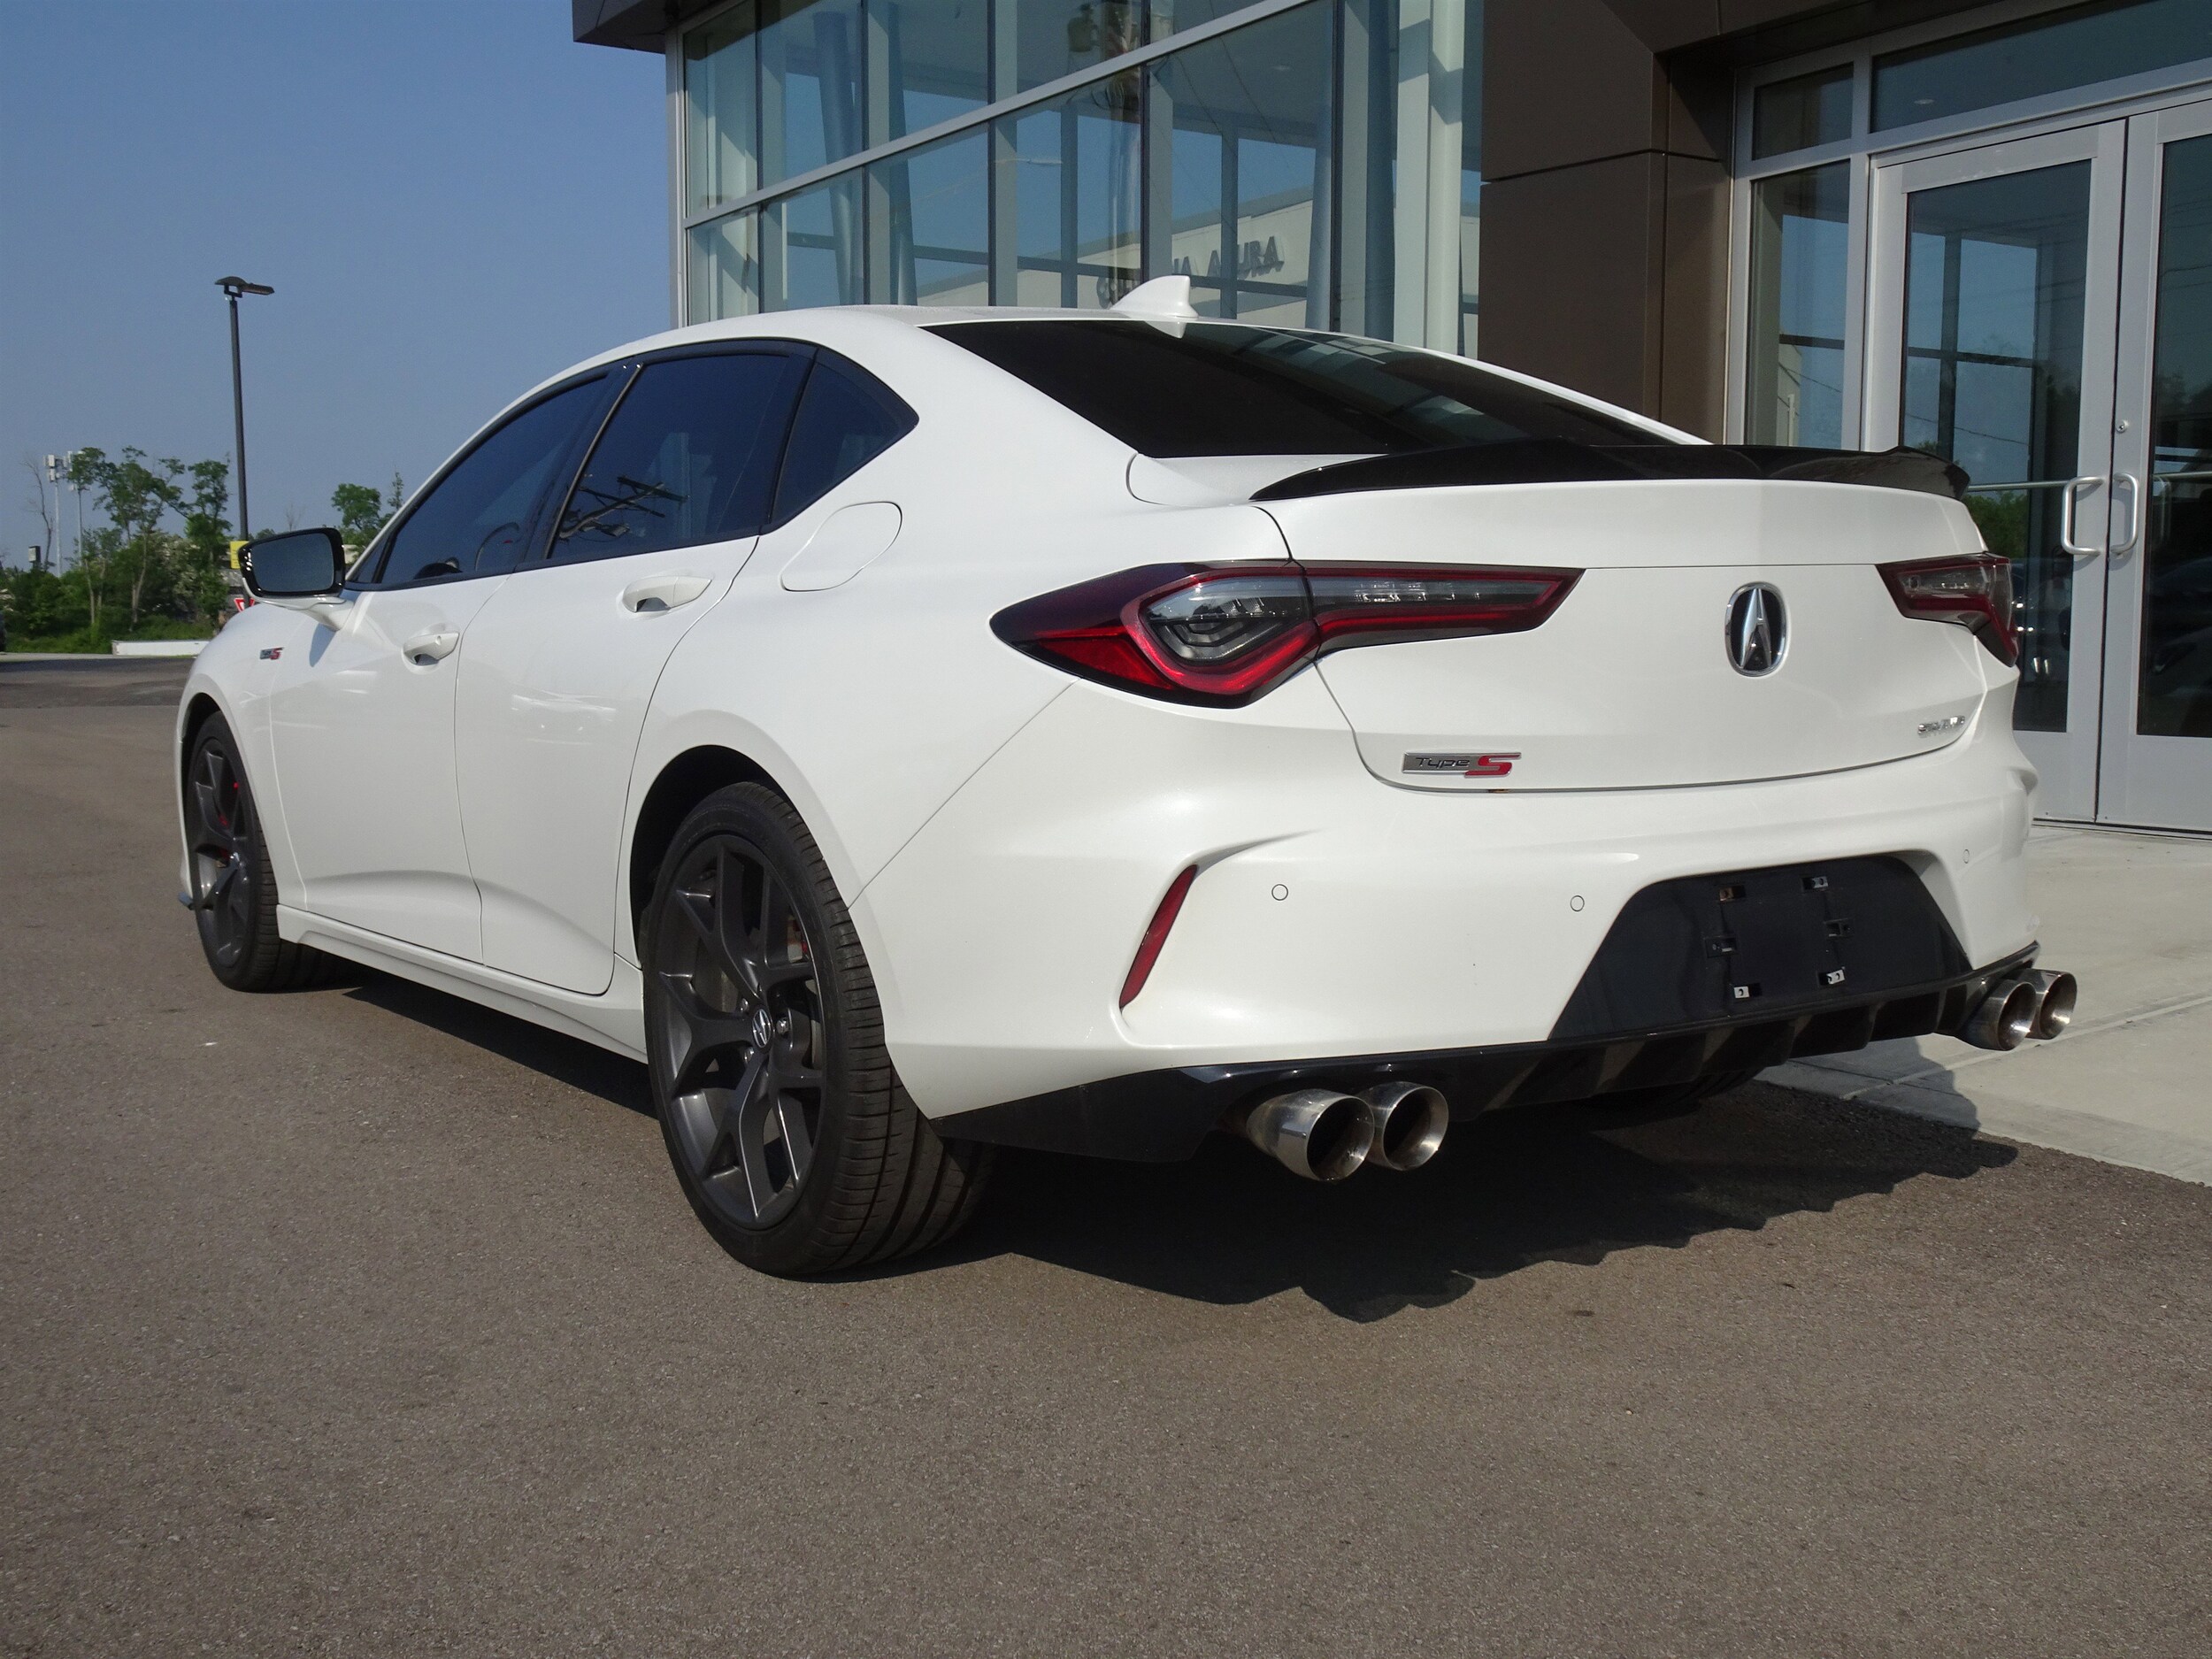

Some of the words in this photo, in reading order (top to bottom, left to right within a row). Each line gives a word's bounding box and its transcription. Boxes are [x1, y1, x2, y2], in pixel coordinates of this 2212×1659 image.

[1206, 235, 1284, 280] AURA
[1416, 757, 1471, 769] Type
[1464, 753, 1521, 777] S
